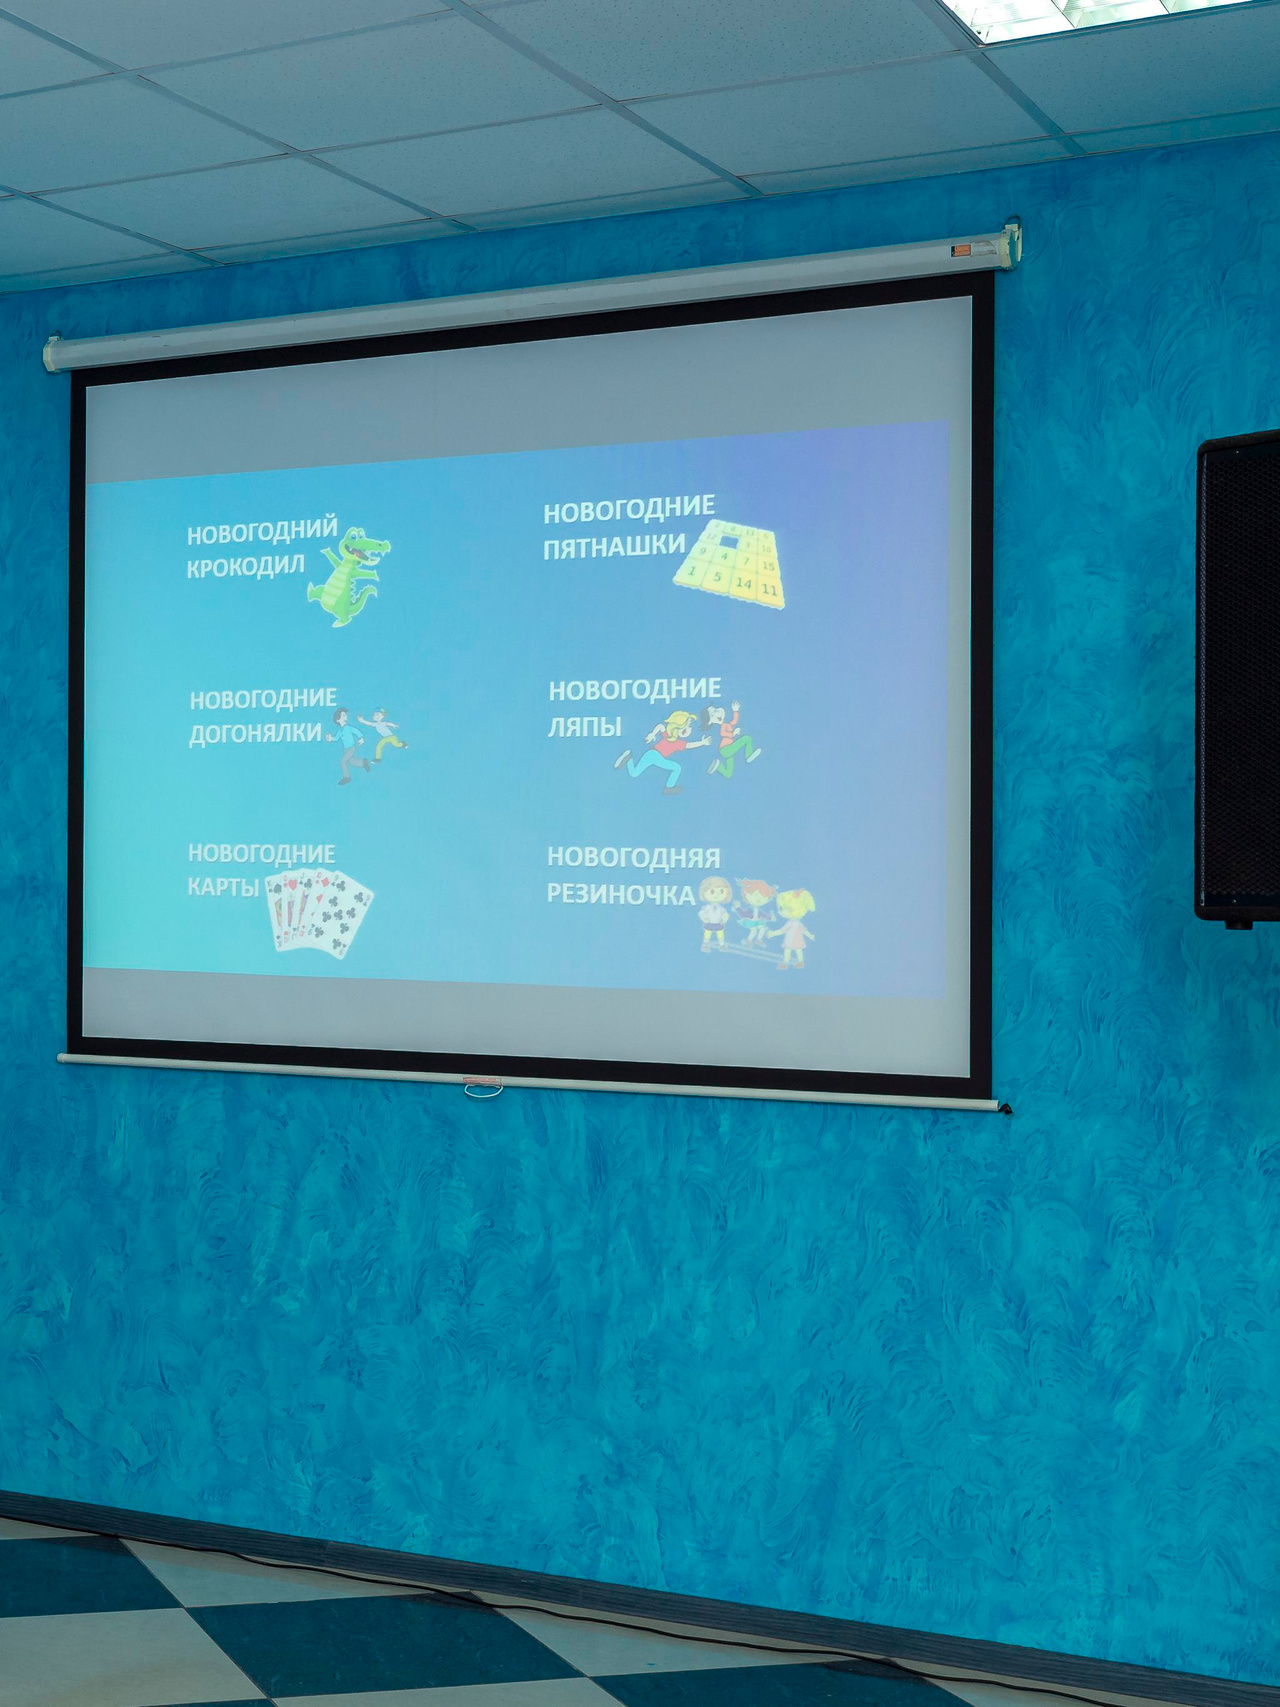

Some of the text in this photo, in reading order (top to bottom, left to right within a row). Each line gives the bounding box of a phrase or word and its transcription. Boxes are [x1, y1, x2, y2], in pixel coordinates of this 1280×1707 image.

[543, 494, 716, 524] НОВОГОДНИЕ
[187, 513, 339, 545] НОВОГОДНИЙ
[543, 533, 686, 561] ПЯТНАШКИ
[186, 554, 305, 580] КРОКОДИЛ
[763, 561, 775, 572] 15
[687, 566, 778, 596] 1 5 14 11
[190, 687, 337, 713] НОВОГОДНИЕ
[549, 677, 722, 705] НОВОГОДНИЕ
[189, 722, 322, 749] ДОГОНЯЛКИ
[548, 716, 622, 738] ЛЯПЫ
[188, 843, 336, 869] НОВОГОДНИЕ
[547, 846, 721, 874] НОВОГОДНЯЯ
[188, 878, 260, 898] КАРТЫ
[547, 882, 697, 906] РЕЗИНОЧКА
